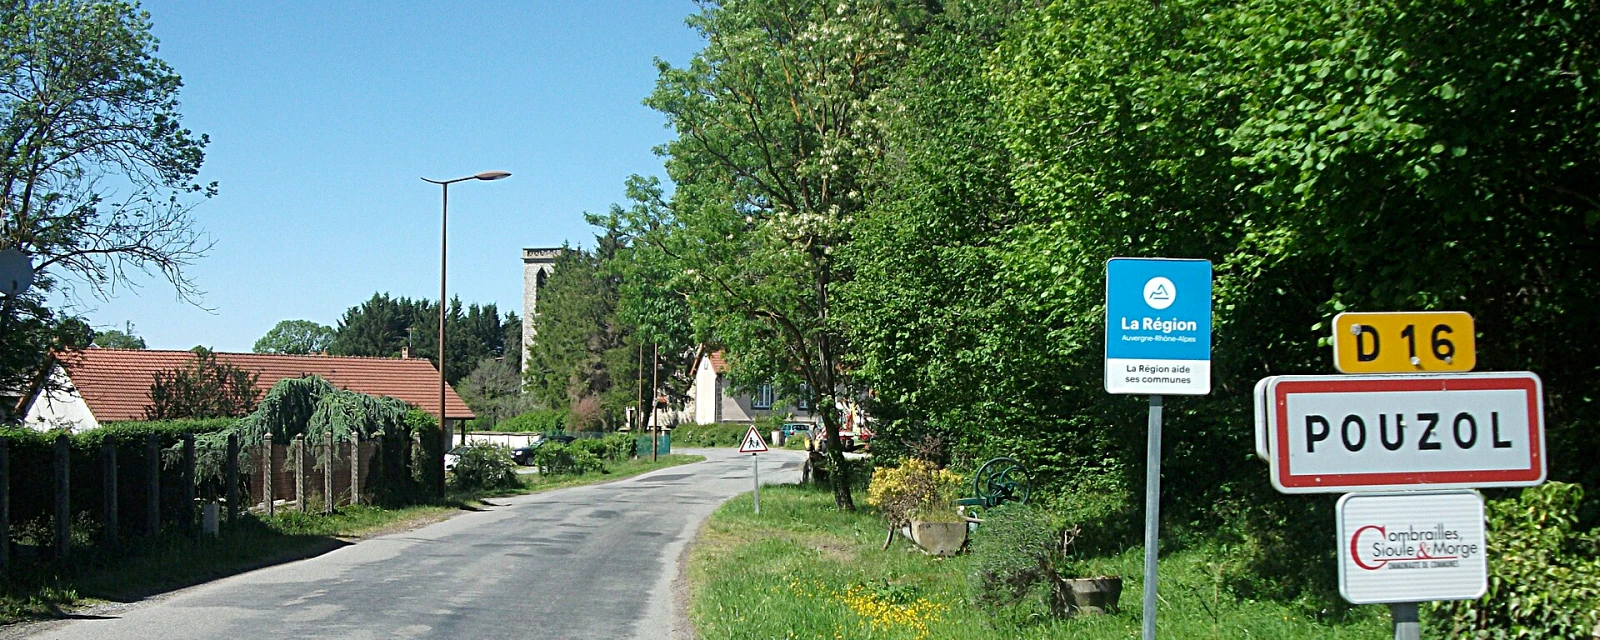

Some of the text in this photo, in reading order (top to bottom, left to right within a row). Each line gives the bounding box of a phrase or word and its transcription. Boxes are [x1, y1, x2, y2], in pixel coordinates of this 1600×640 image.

[1121, 317, 1197, 333] La Région
[1354, 324, 1455, 363] D 16
[1126, 365, 1191, 374] La Région aide
[1125, 376, 1191, 384] ses communes
[1305, 412, 1513, 453] POUZOL
[1350, 523, 1464, 571] Combrailles,
[1373, 542, 1415, 558] Sioule
[1433, 542, 1478, 559] Morge
